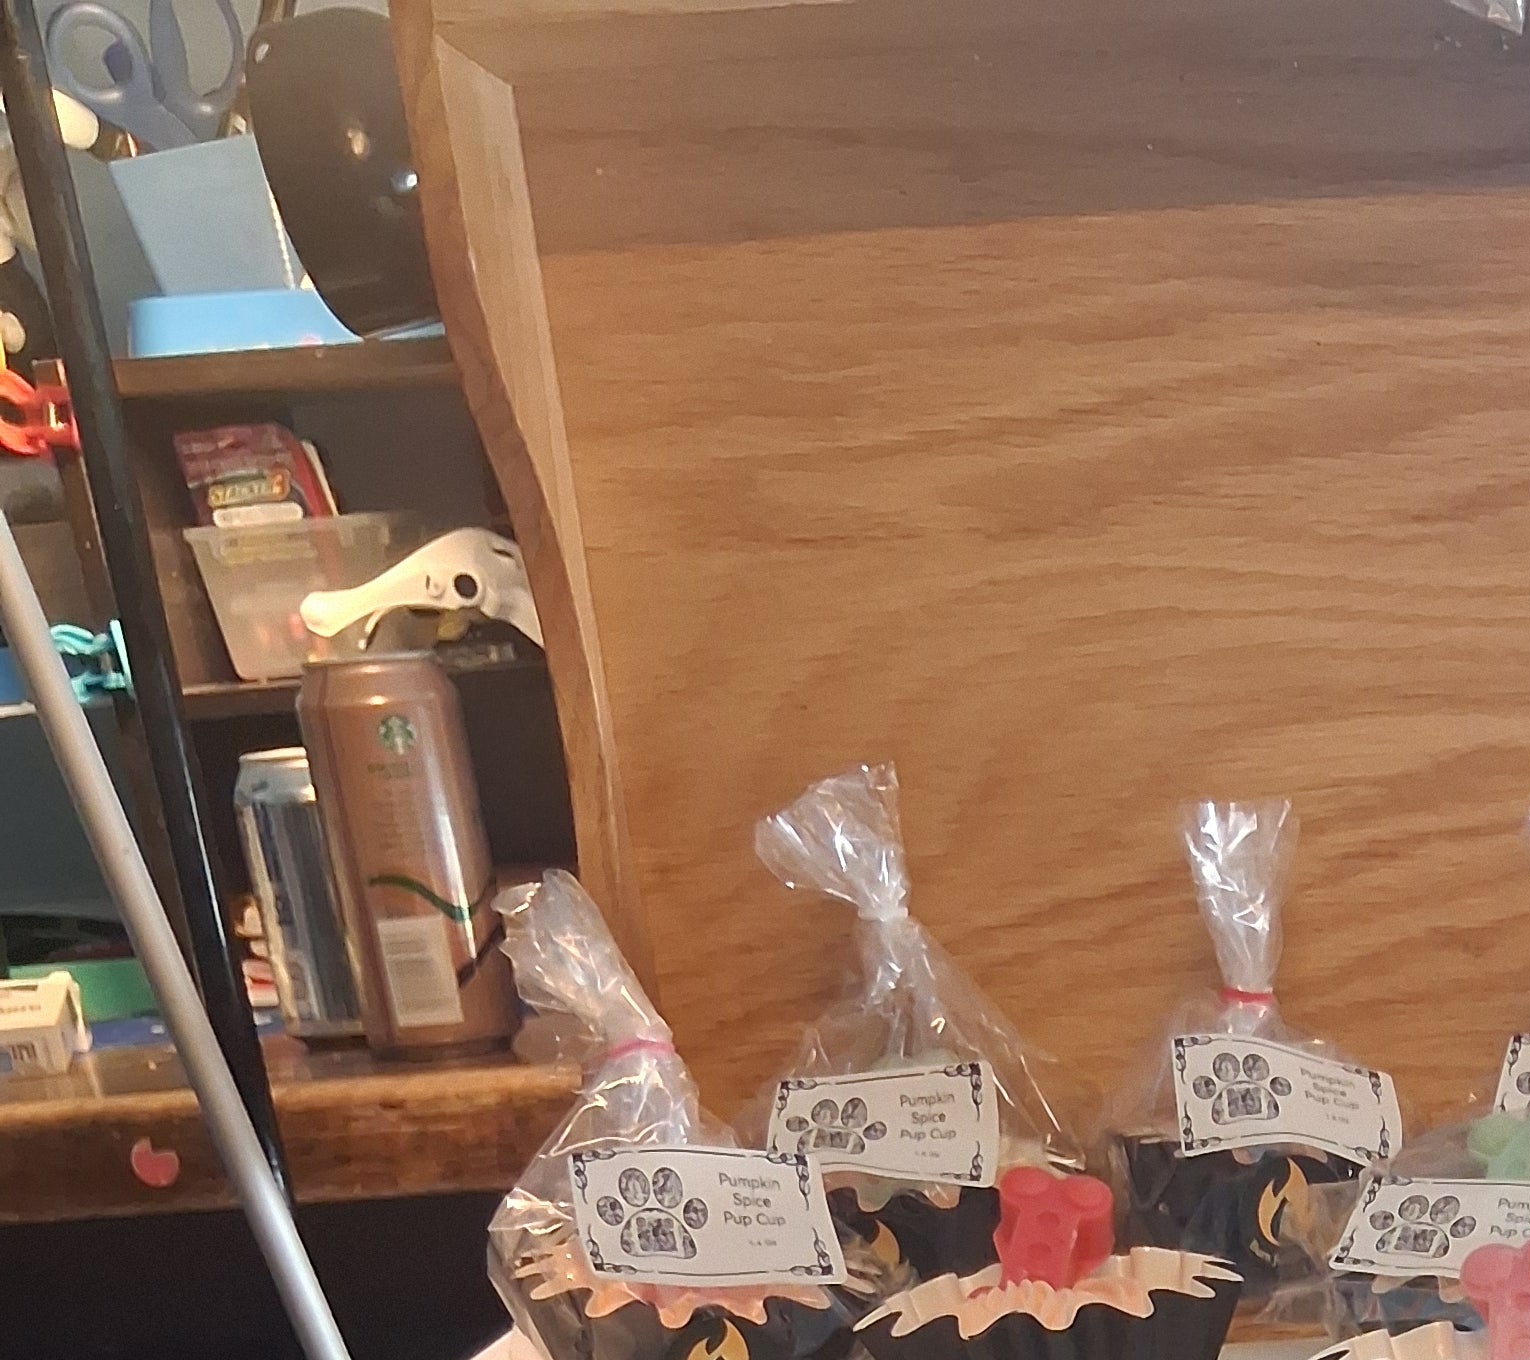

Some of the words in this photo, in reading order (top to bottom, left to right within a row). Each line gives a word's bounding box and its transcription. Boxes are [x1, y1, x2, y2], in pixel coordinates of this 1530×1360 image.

[899, 1090, 956, 1108] Pumpkin
[911, 1111, 946, 1127] Spice
[900, 1128, 927, 1141] Pup
[929, 1127, 958, 1140] Cup
[718, 1171, 781, 1191] Pumpkin
[732, 1192, 772, 1209] Spice
[723, 1210, 753, 1228] Pup
[755, 1212, 787, 1227] Cup
[1489, 1224, 1519, 1239] Pup
